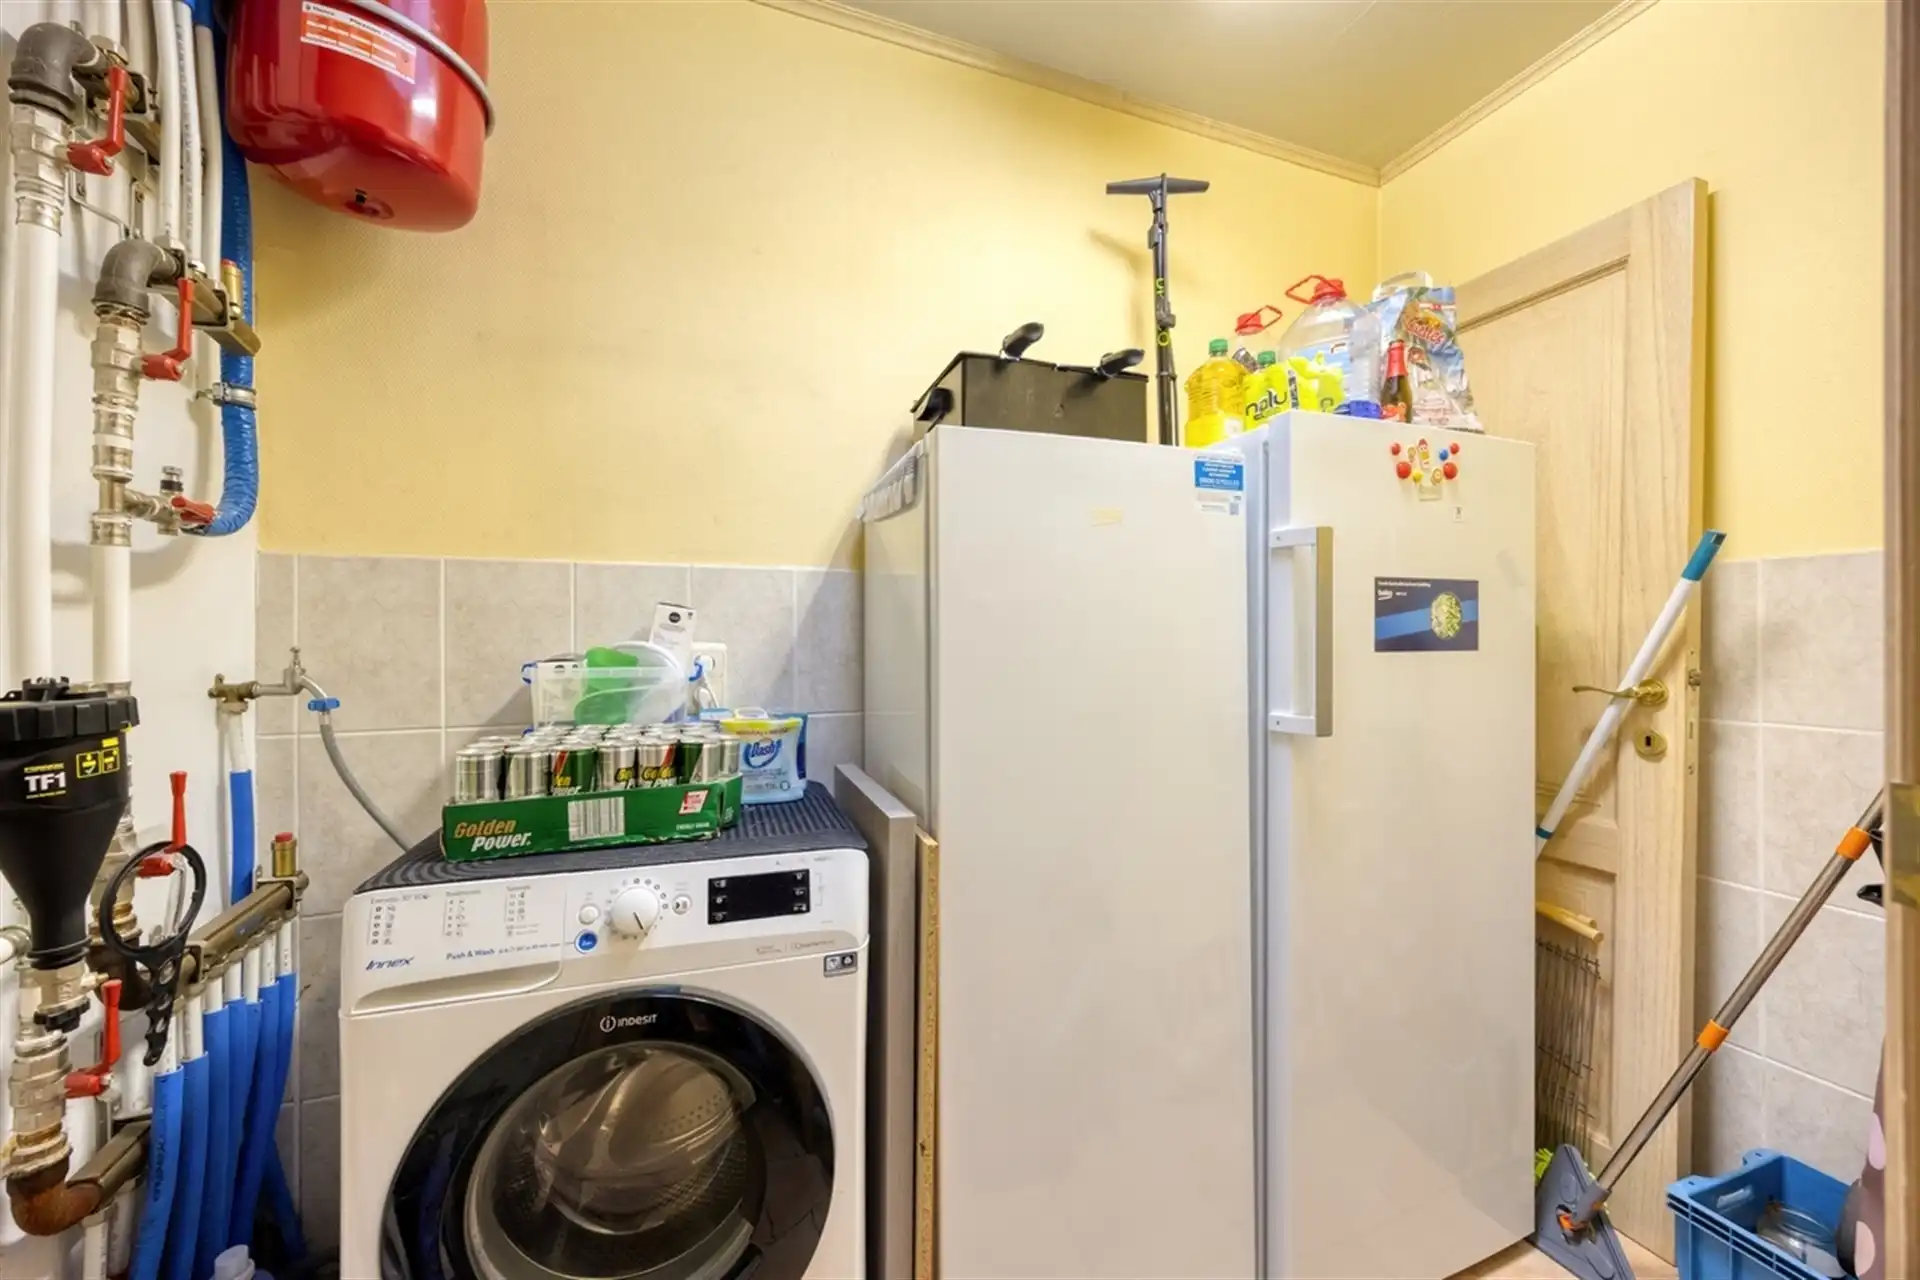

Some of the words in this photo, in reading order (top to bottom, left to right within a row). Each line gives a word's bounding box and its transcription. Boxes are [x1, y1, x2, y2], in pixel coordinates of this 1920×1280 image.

[750, 742, 776, 757] Dash
[24, 771, 66, 792] TF1
[454, 819, 517, 838] Golden
